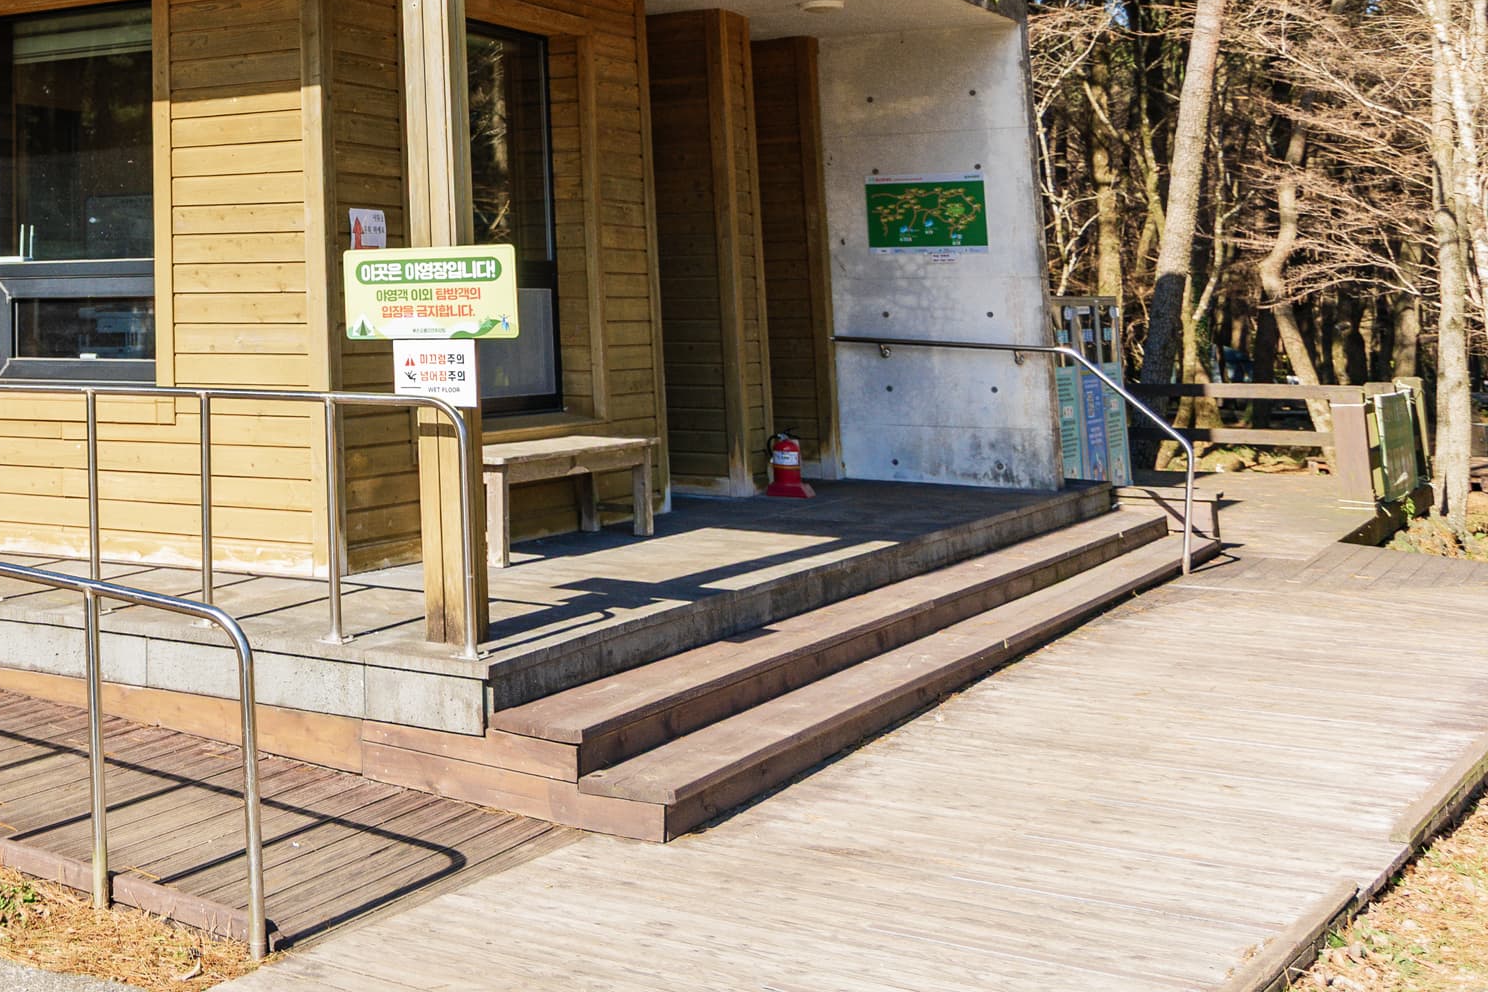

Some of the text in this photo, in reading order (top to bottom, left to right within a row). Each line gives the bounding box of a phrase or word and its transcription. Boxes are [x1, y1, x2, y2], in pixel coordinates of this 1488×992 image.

[360, 260, 496, 281] 이곳은 야영장입니다!
[376, 287, 481, 302] 야영객 이외 탐방객의
[382, 303, 476, 319] 입장을 금지합니다.
